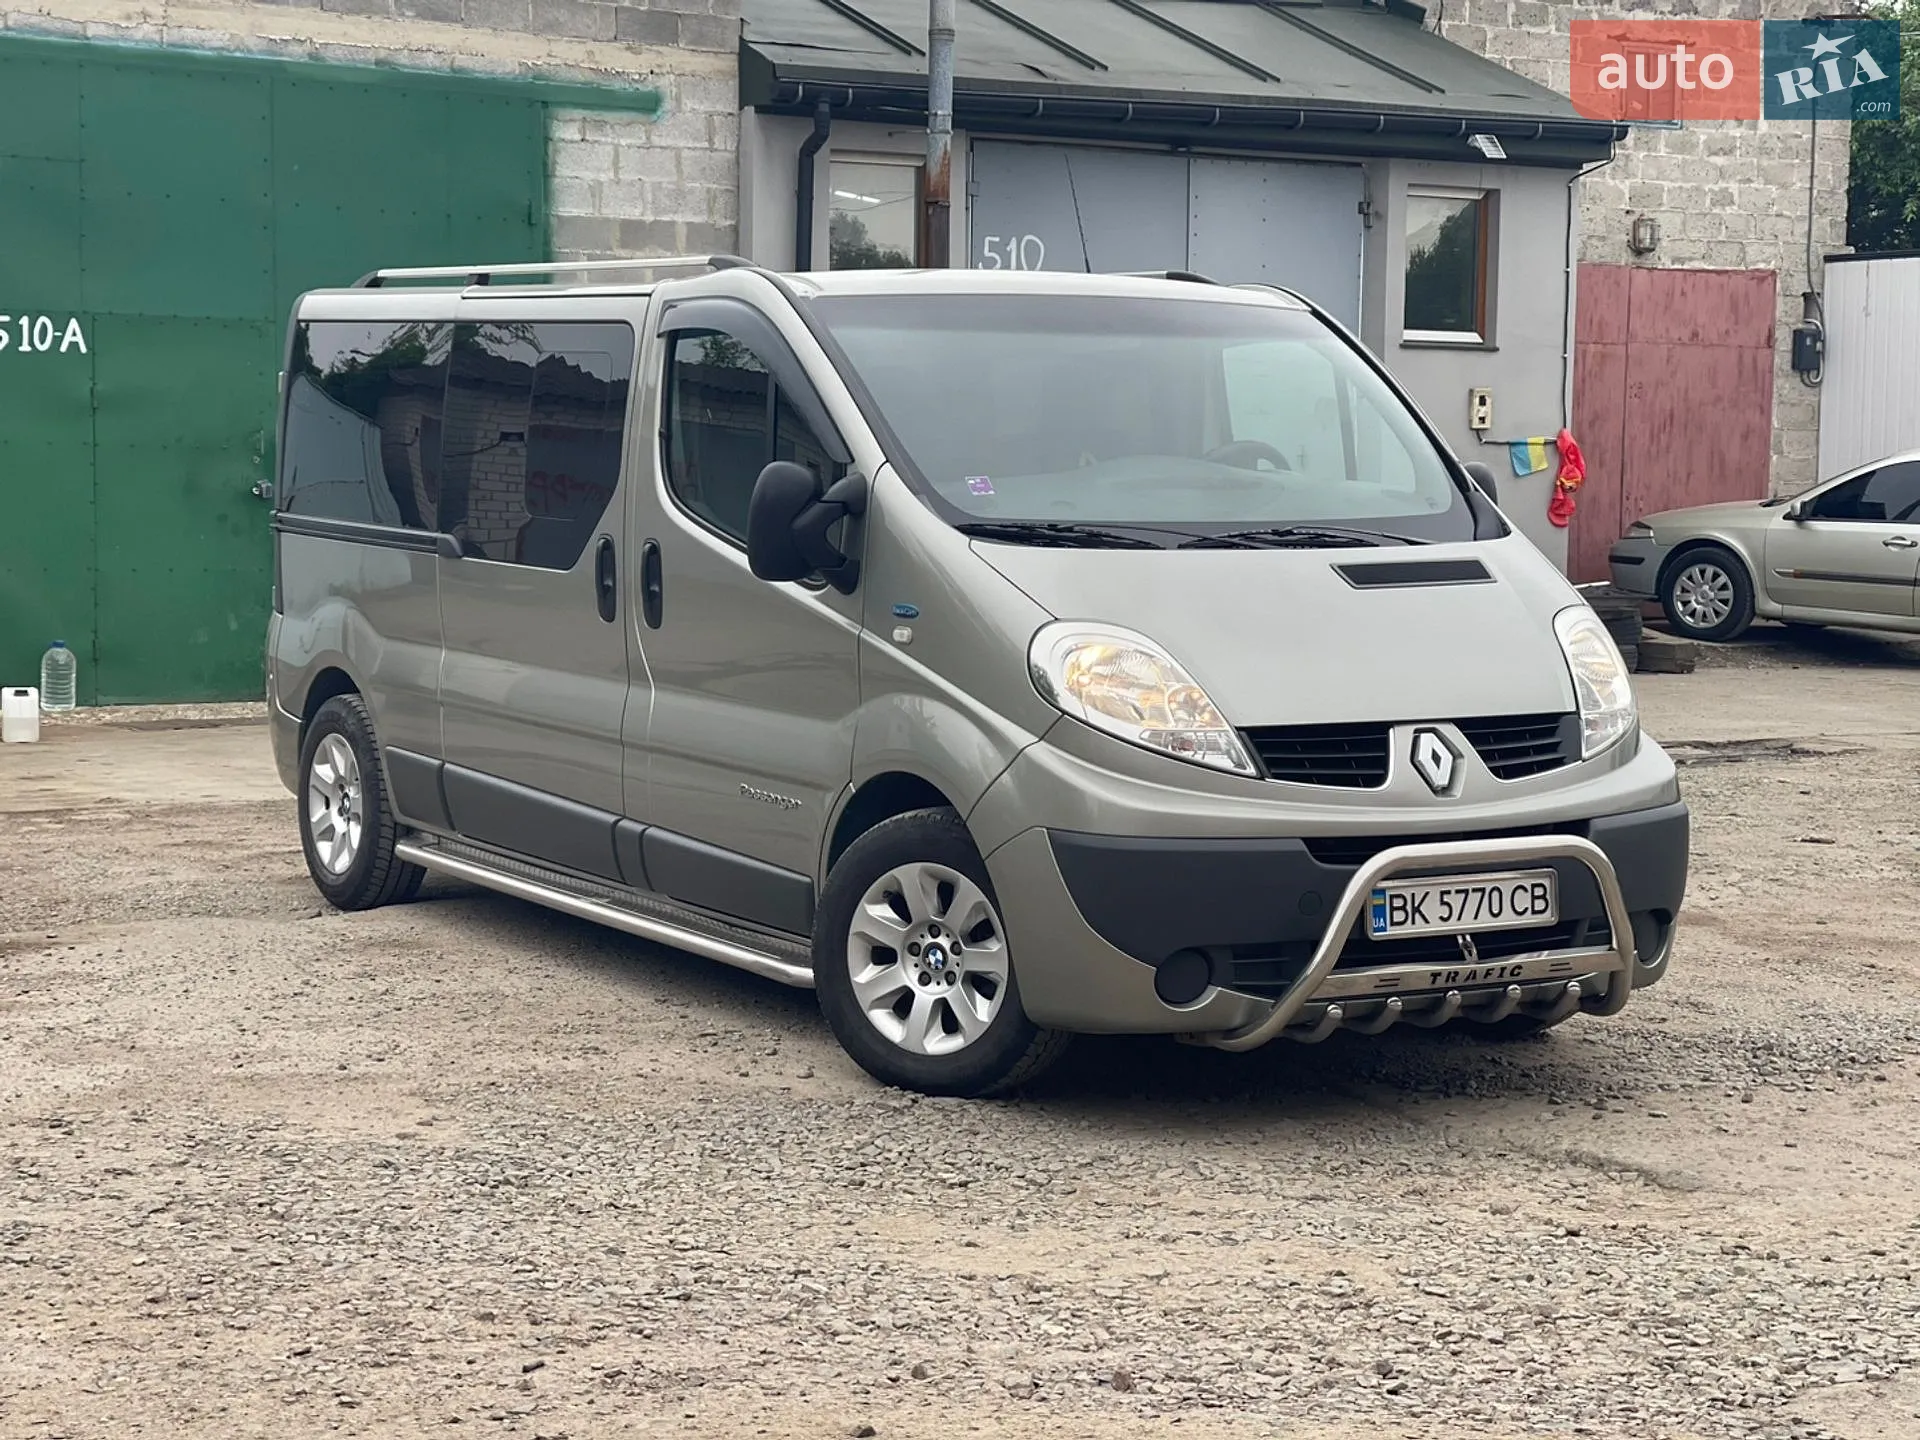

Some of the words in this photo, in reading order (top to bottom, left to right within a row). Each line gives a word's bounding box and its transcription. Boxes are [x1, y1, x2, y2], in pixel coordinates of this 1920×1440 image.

[979, 234, 1045, 271] 510
[1389, 892, 1430, 927] BK
[1438, 886, 1503, 922] 5770
[1510, 882, 1550, 916] CB
[1373, 916, 1385, 928] UA
[1430, 964, 1523, 985] TRAFIC
